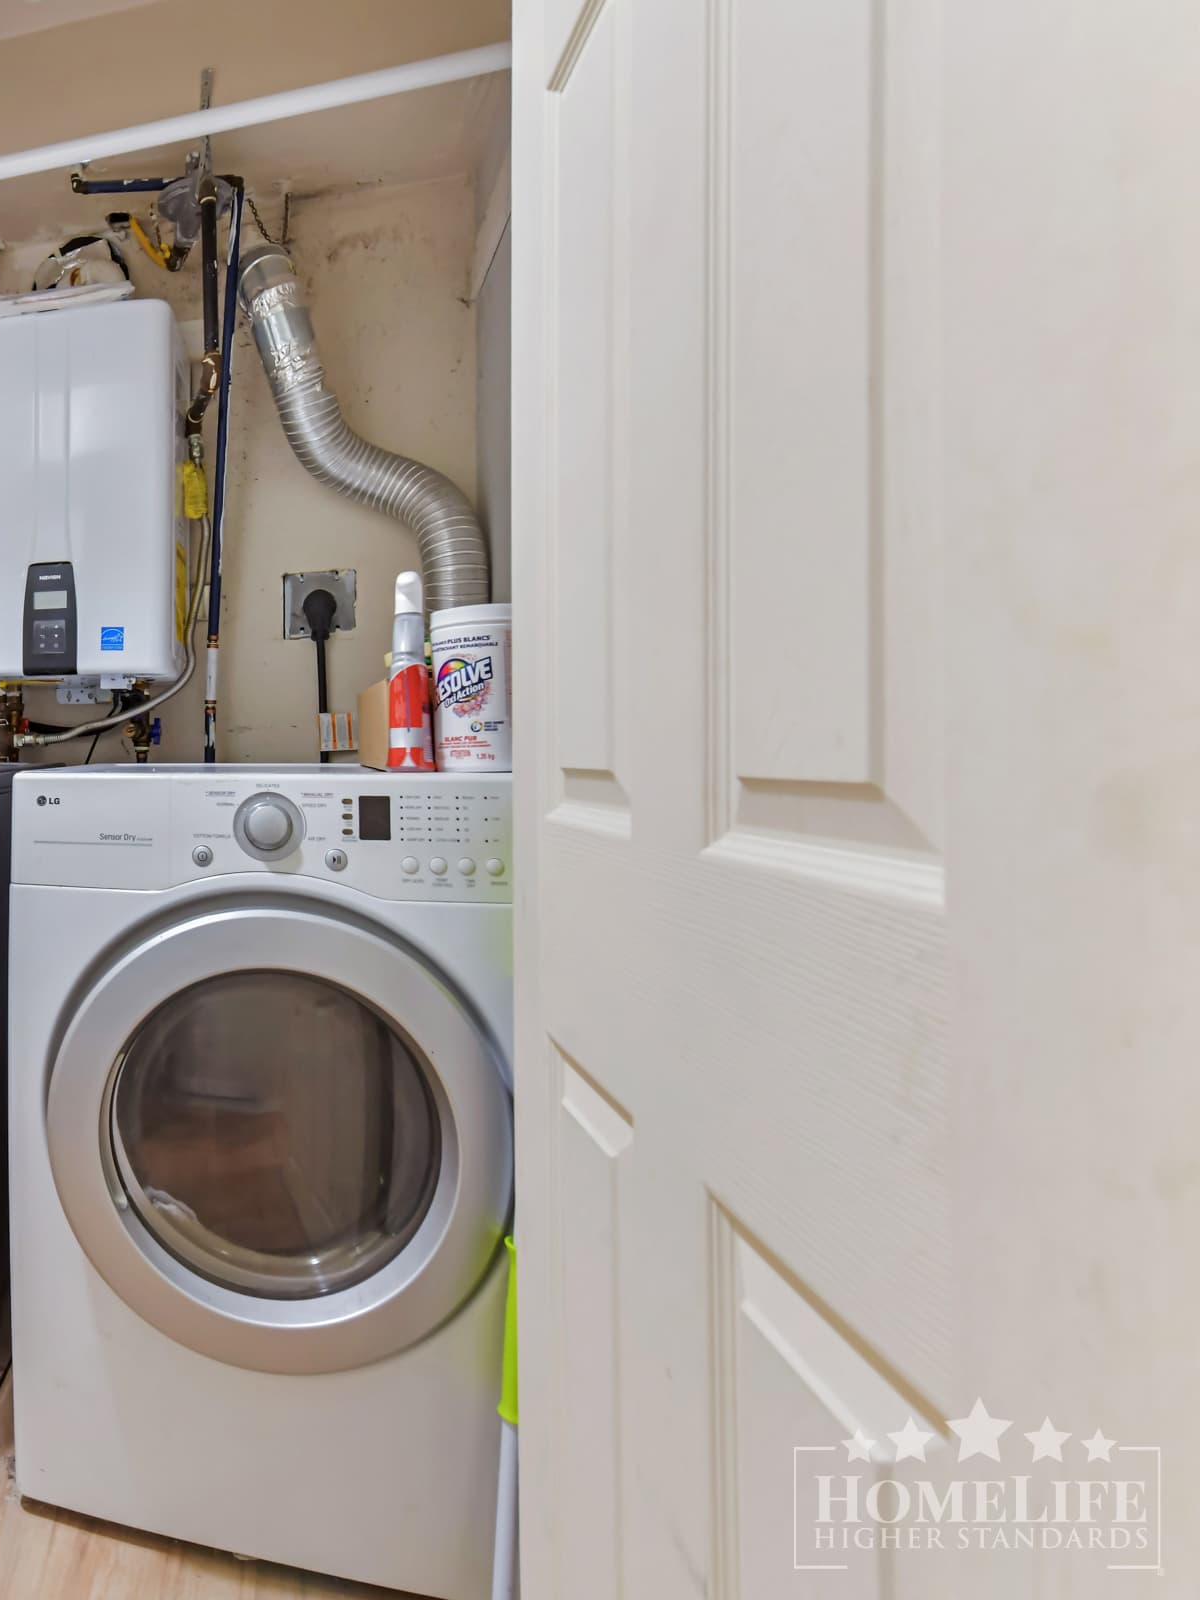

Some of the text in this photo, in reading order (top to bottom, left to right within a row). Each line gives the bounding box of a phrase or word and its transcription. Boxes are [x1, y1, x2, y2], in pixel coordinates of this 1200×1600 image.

[463, 635, 490, 643] BLANCS
[99, 833, 123, 841] Sensor
[124, 834, 137, 842] Dry
